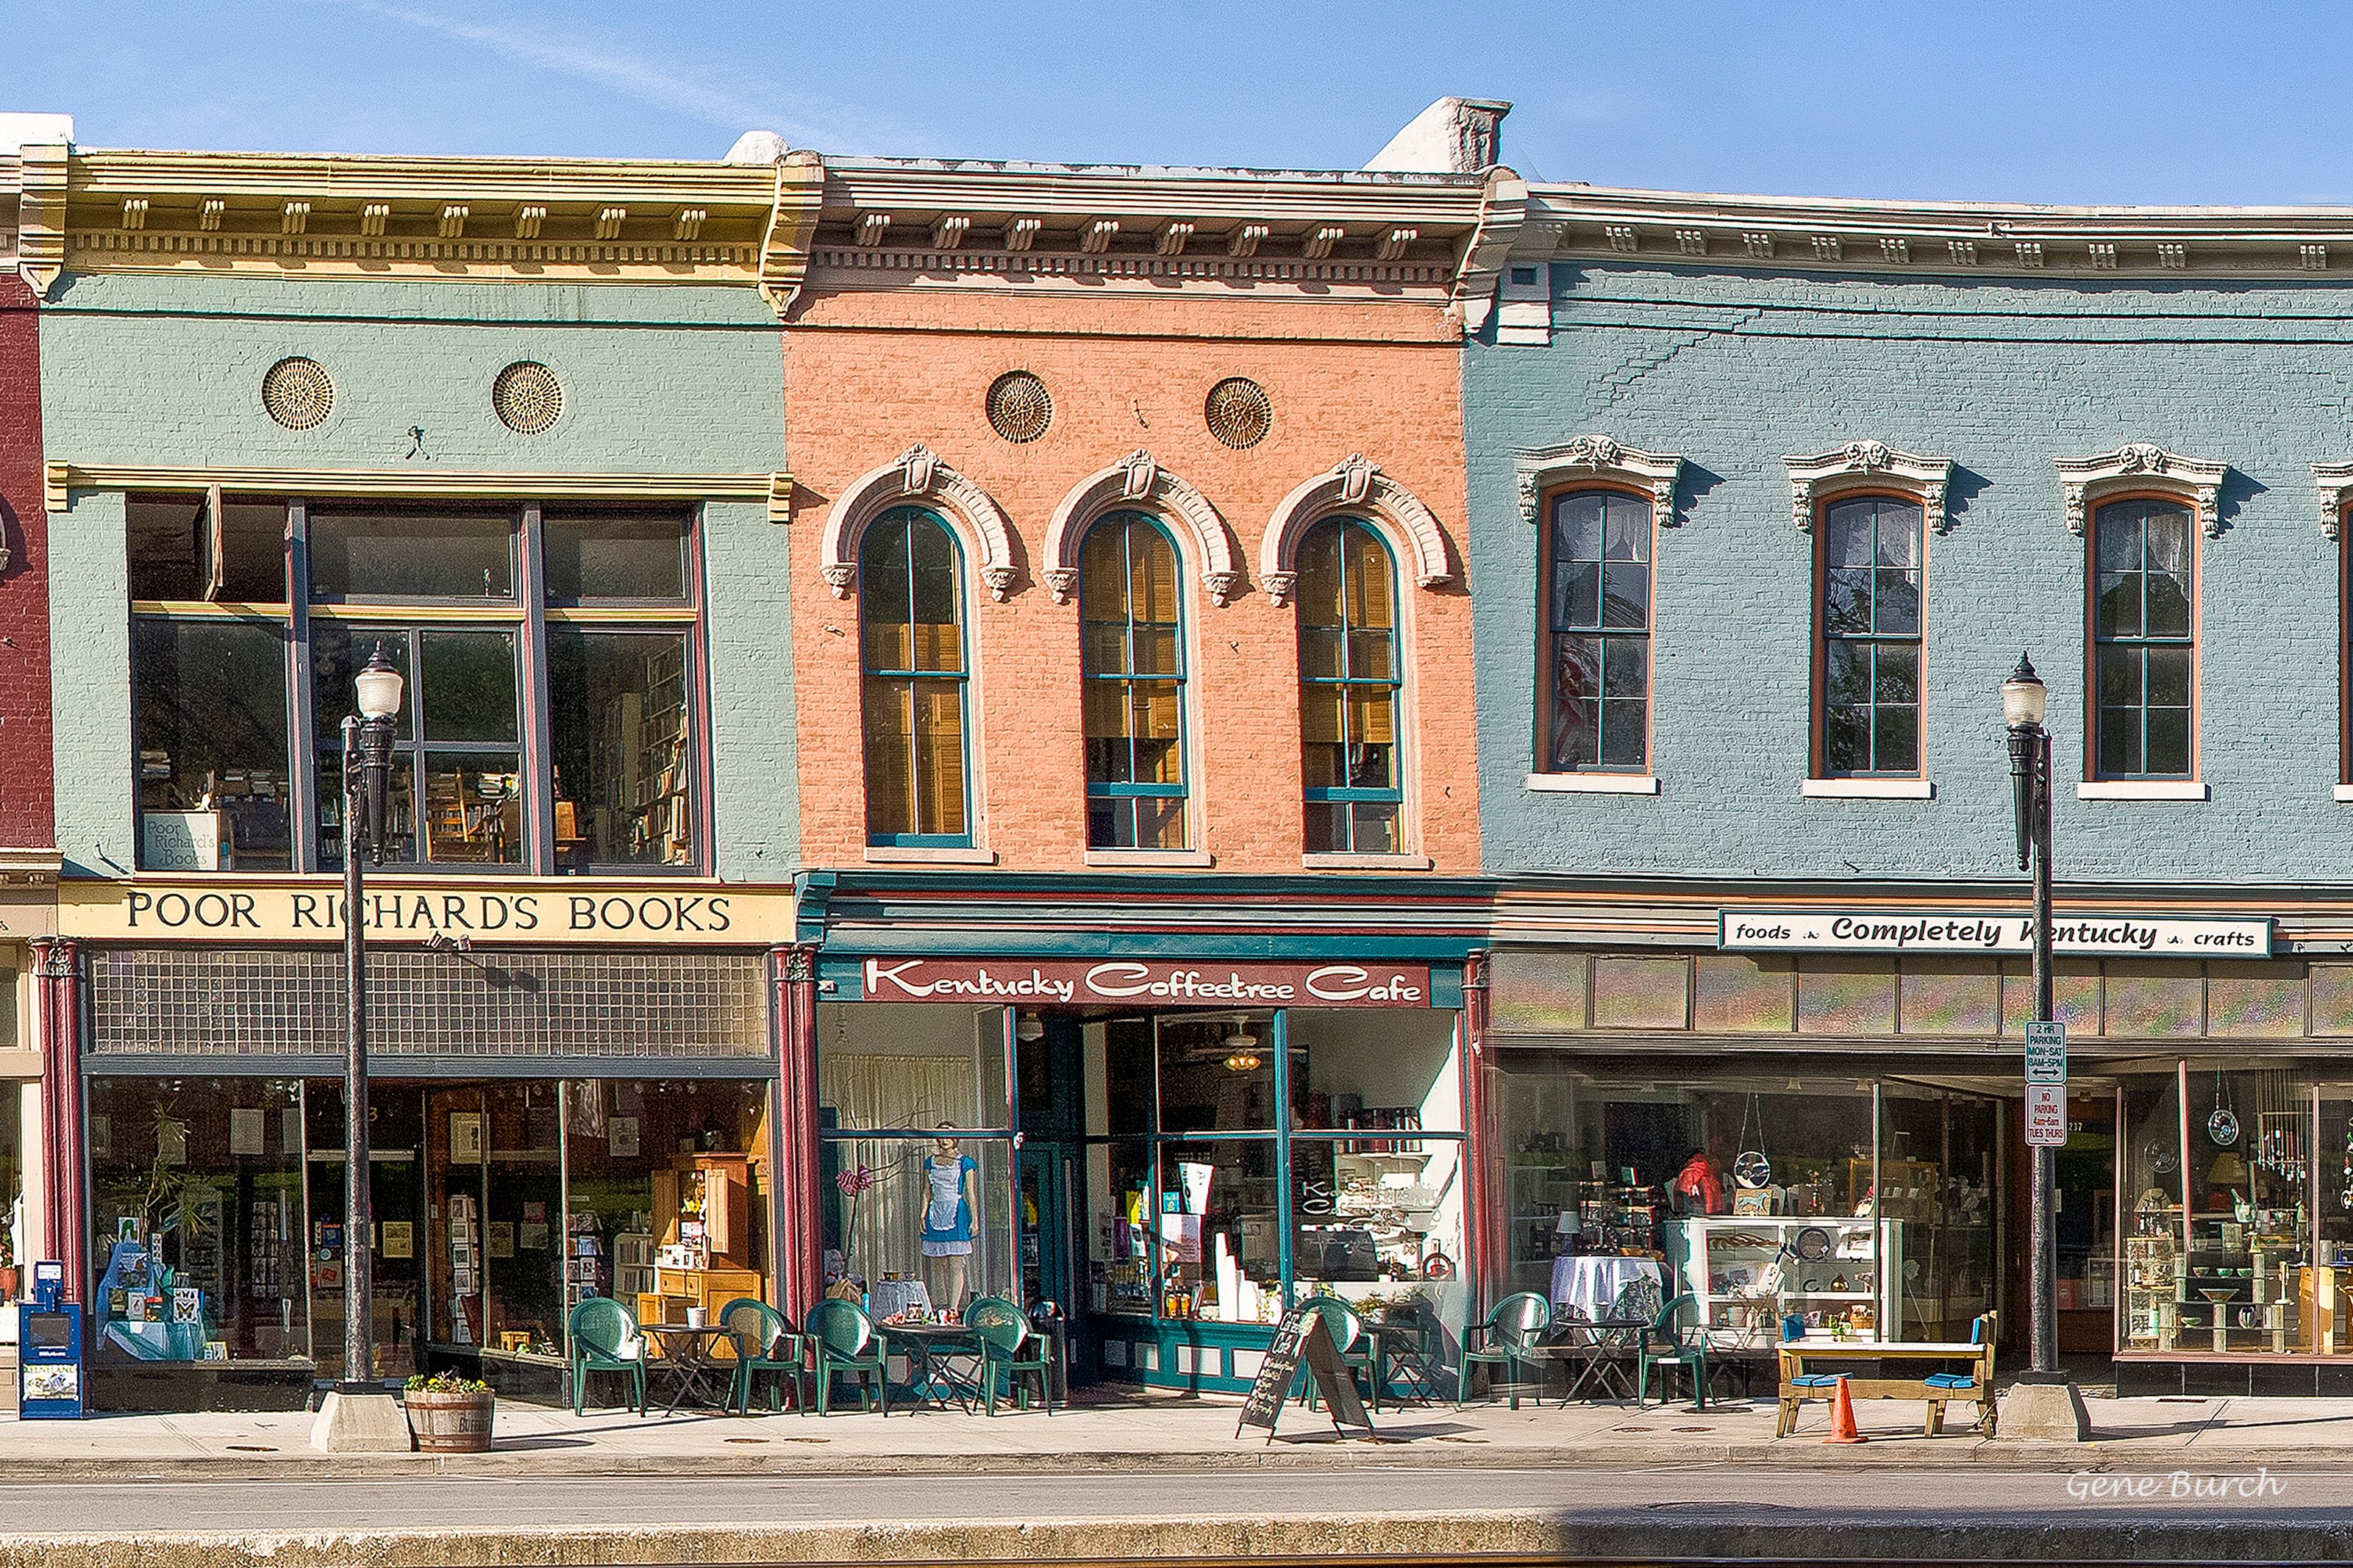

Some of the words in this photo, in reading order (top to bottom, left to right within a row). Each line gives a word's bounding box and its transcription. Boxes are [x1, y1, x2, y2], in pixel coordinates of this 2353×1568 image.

[148, 821, 181, 834] Poor
[160, 848, 207, 866] Books
[127, 892, 260, 927] POOR
[291, 894, 539, 929] RICHARD'S
[568, 896, 730, 931] BOOKS
[1736, 924, 1791, 939] foods
[1832, 917, 2002, 948] Completely
[2193, 931, 2255, 947] crafts
[865, 958, 1075, 1003] Kentucky
[1085, 962, 1296, 998] Coffeetree
[1305, 964, 1421, 1002] Cafe
[2036, 1025, 2042, 1034] 2
[2044, 1025, 2054, 1034] HR
[2029, 1035, 2061, 1045] PARKING
[2028, 1047, 2063, 1056] MON-SAT
[2029, 1058, 2063, 1067] 8AM-5PM
[2041, 1092, 2051, 1101] NO
[2034, 1104, 2058, 1114] PARKING
[2068, 1122, 2082, 1131] 237
[2029, 1128, 2043, 1138] TUES
[2046, 1128, 2063, 1138] THURS
